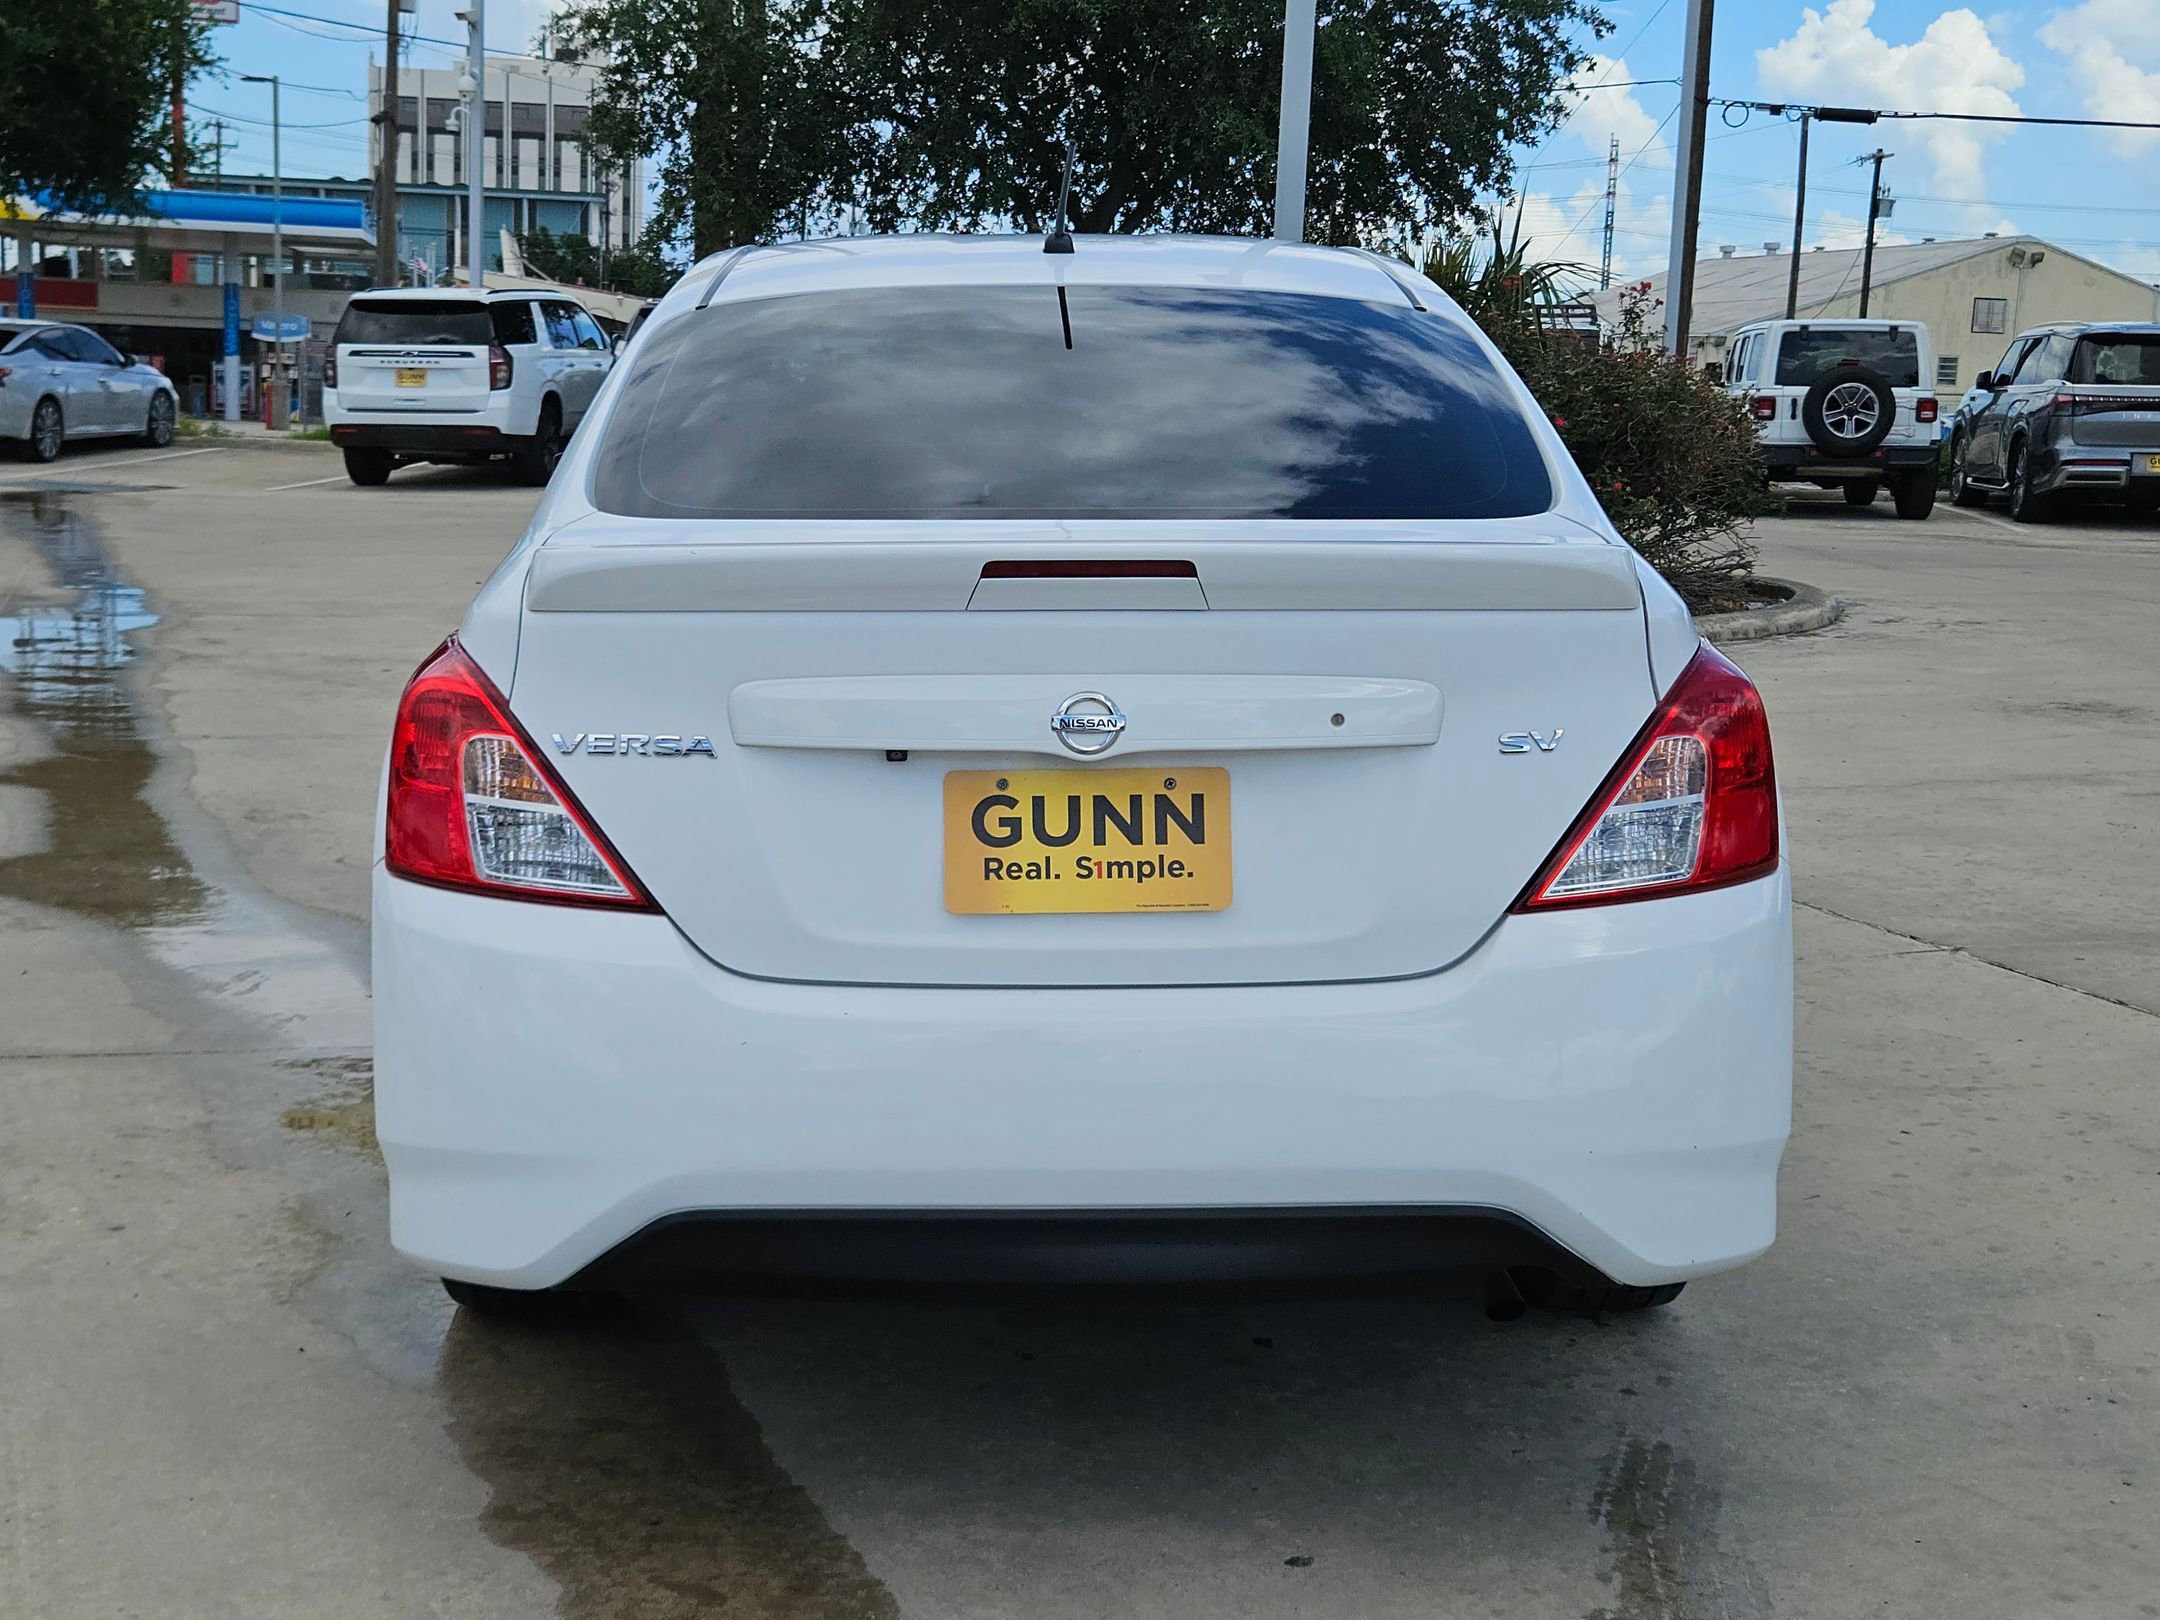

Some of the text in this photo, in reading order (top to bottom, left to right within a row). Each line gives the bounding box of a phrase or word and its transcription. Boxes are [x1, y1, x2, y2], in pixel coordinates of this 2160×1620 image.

[1060, 718, 1117, 728] NISSAN
[552, 733, 718, 759] VERSA
[1499, 729, 1564, 753] SV
[971, 793, 1206, 848] GUNN
[983, 855, 1061, 881] Real.
